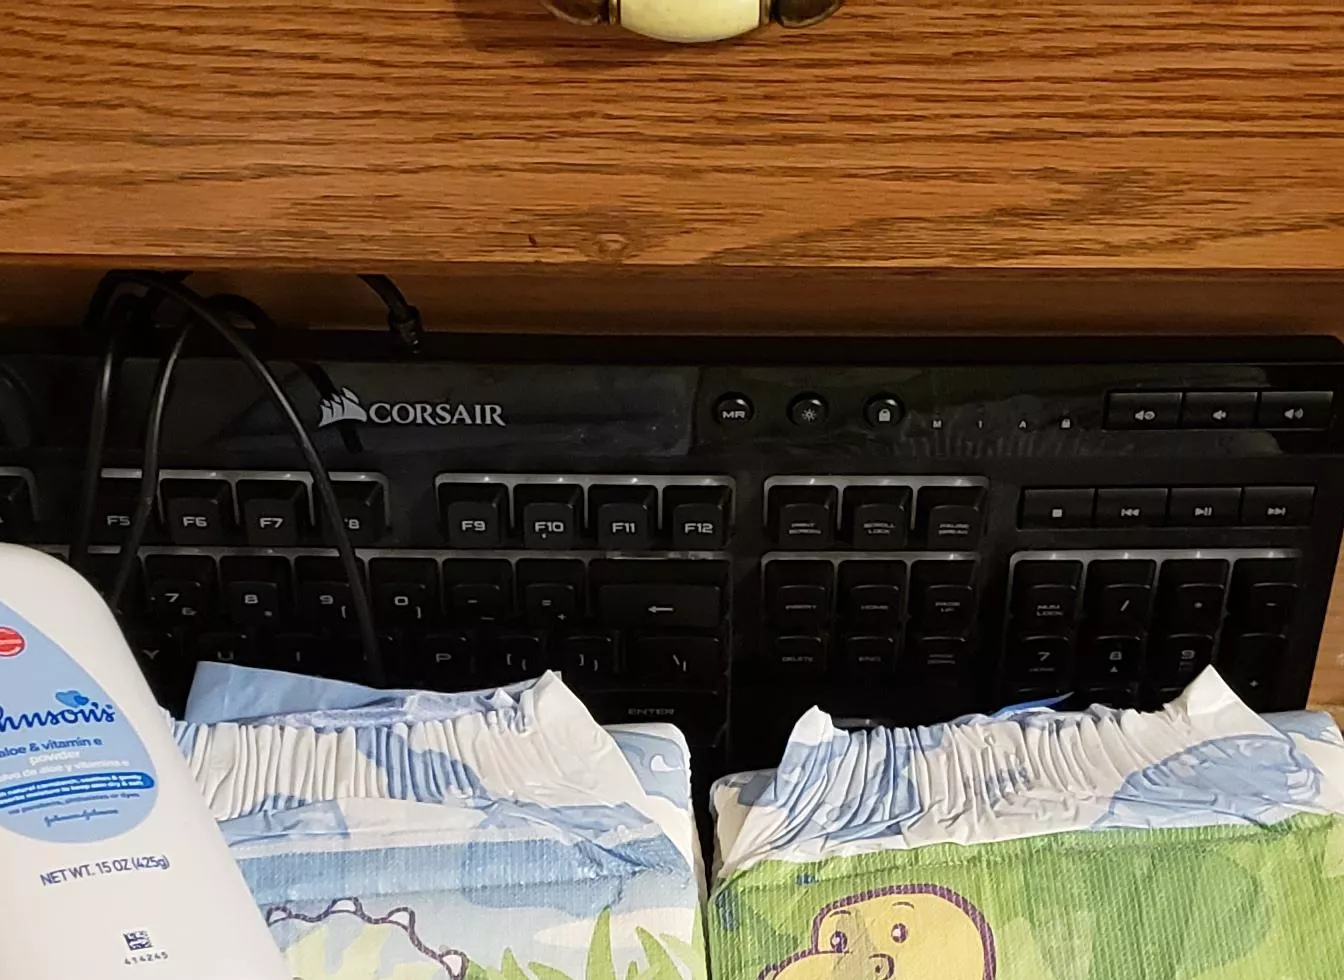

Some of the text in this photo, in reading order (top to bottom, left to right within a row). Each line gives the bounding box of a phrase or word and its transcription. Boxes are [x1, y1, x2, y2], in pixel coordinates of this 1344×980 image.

[367, 402, 506, 427] CORSAIR
[722, 409, 745, 420] MR
[105, 515, 132, 527] F5
[181, 516, 208, 529] F6
[258, 516, 284, 529] F7
[460, 519, 487, 533] F9
[534, 520, 565, 534] F10
[611, 521, 636, 534] F11
[684, 521, 714, 535] F12
[164, 592, 181, 604] 7
[243, 592, 259, 605] 8
[319, 593, 334, 606] 9
[435, 652, 452, 663] P
[29, 741, 41, 753] &
[42, 736, 91, 752] vitamin
[92, 737, 103, 746] e
[28, 750, 81, 767] powder
[39, 854, 171, 887] NET WT. 15 OZ (425g)
